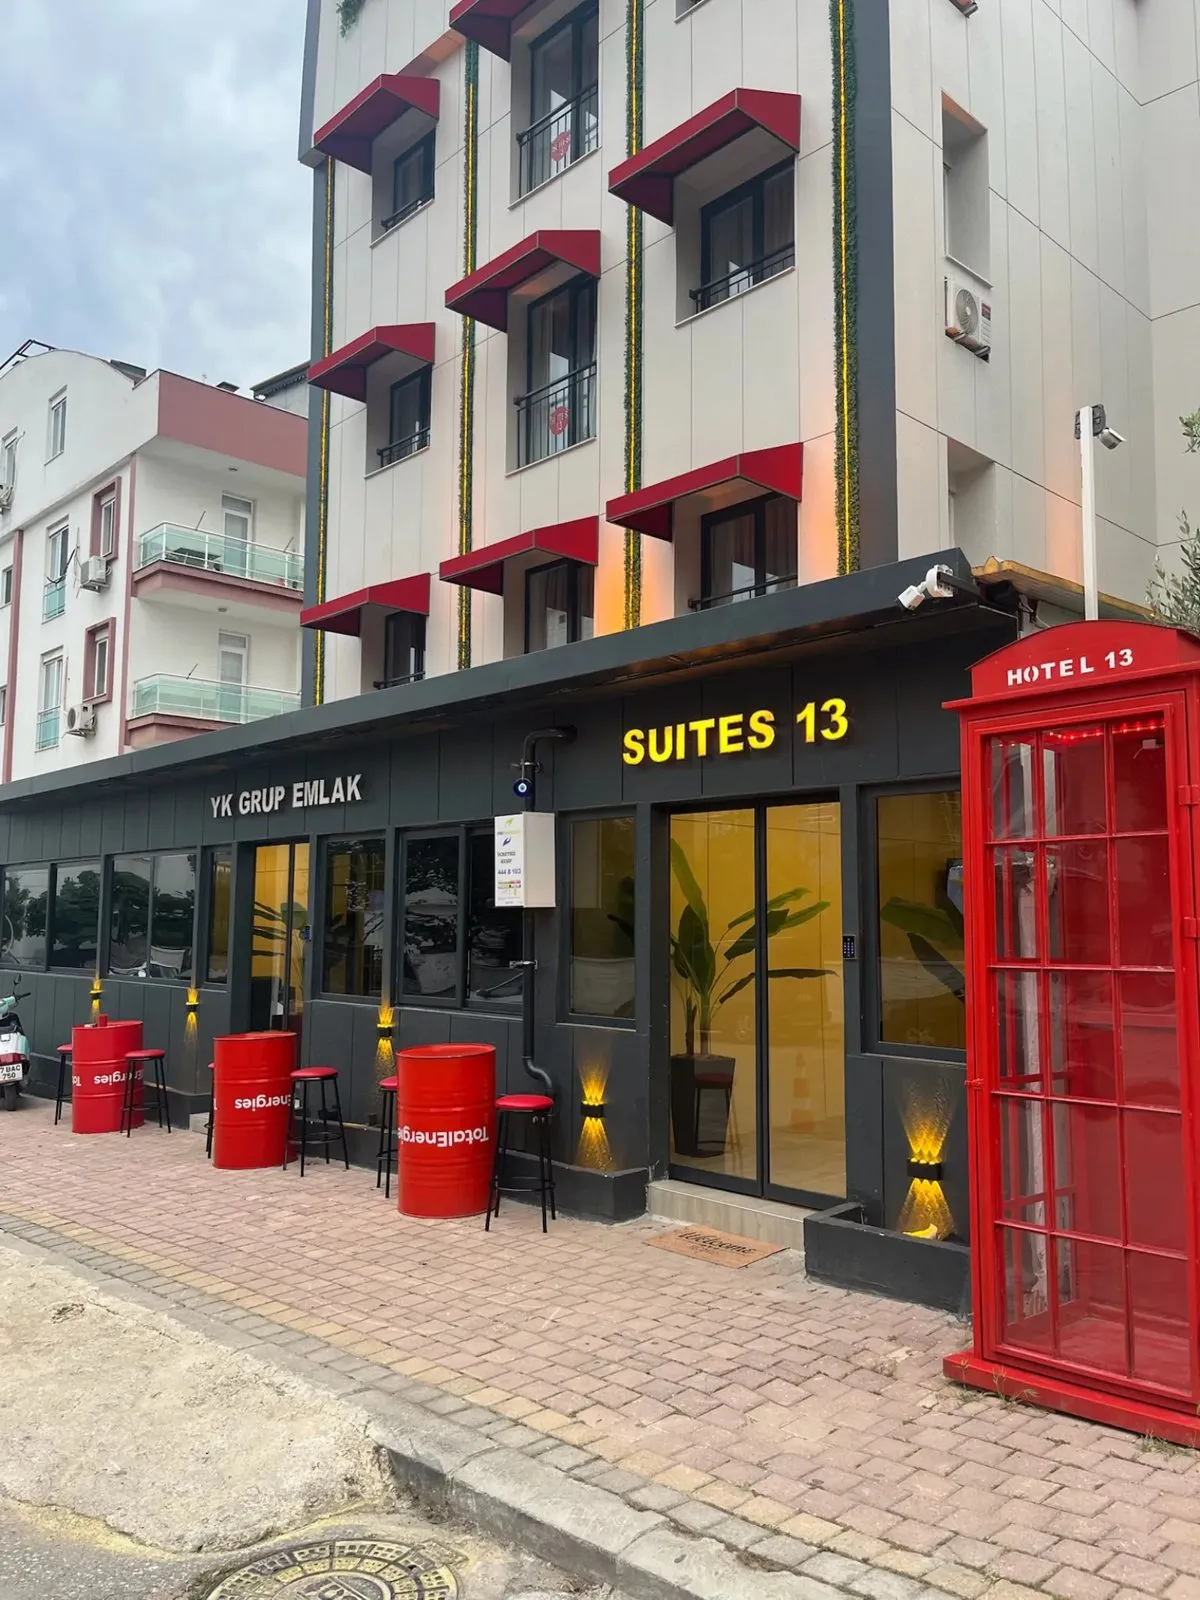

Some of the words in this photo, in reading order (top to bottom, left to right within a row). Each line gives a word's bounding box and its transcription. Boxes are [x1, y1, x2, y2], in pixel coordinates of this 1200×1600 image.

[1007, 656, 1095, 686] HOTEL
[1104, 648, 1134, 669] 13
[622, 709, 776, 766] SUITES
[796, 697, 849, 744] 13
[210, 793, 233, 818] YK
[238, 785, 286, 815] GRUP
[292, 773, 362, 808] EMLAK
[2, 1072, 16, 1080] 750
